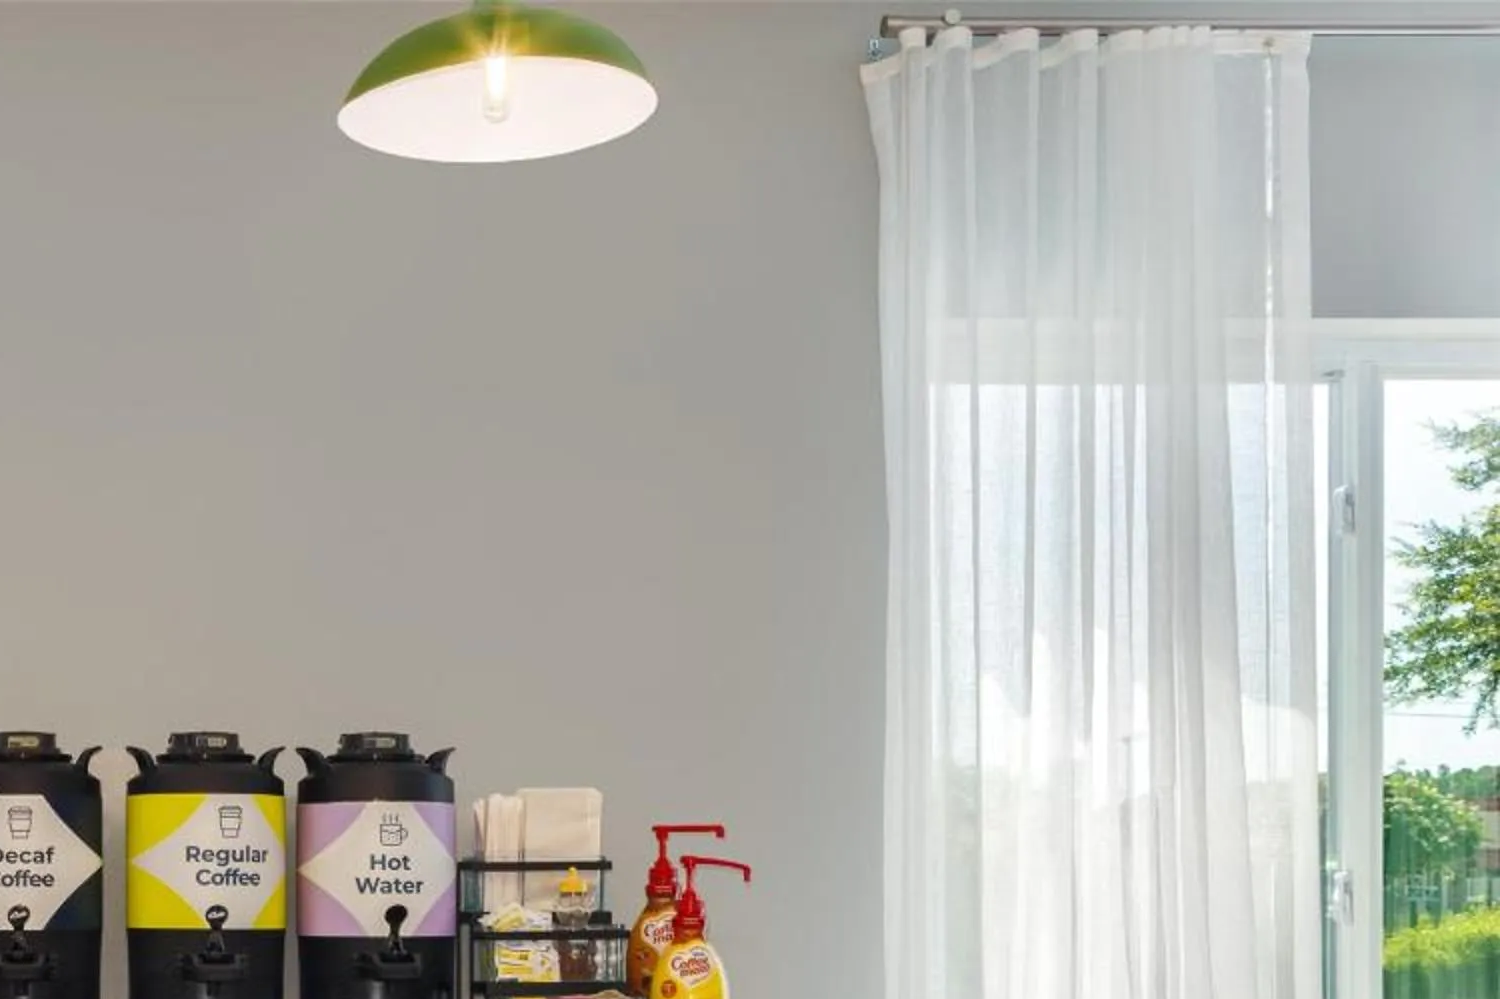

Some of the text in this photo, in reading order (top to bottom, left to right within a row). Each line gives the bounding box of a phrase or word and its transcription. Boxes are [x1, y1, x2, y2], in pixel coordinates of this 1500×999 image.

[185, 845, 268, 867] Regular
[370, 854, 411, 871] Hot
[196, 868, 261, 886] Coffee
[355, 877, 424, 894] Water
